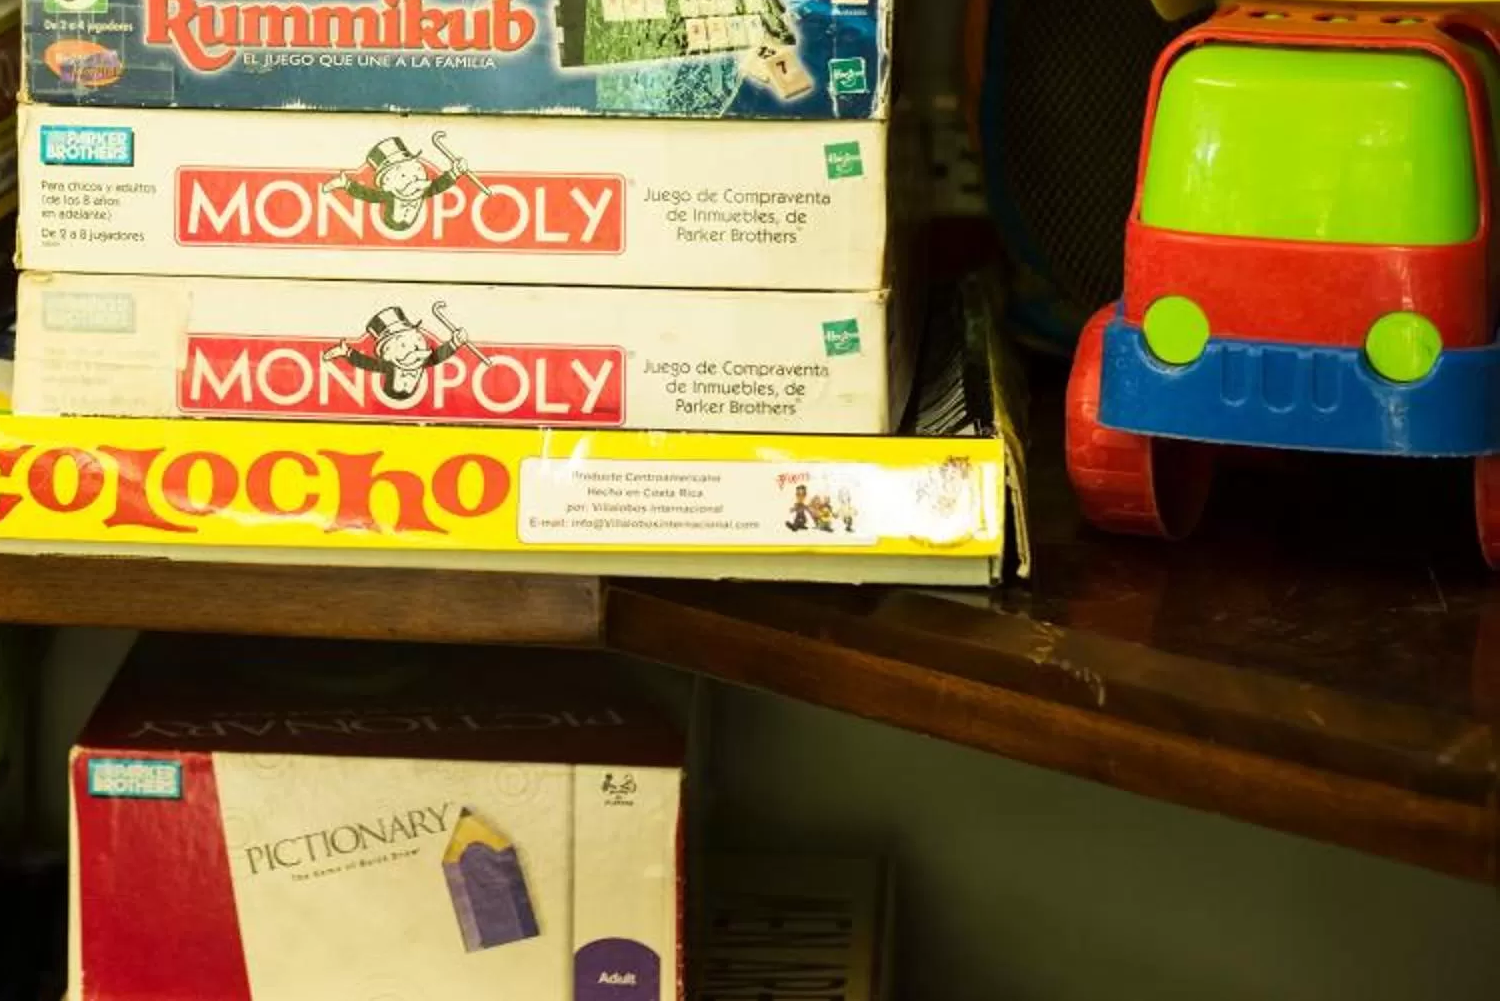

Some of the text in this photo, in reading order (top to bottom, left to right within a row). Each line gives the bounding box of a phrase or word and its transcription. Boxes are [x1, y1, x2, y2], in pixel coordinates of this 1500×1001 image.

[243, 53, 496, 69] EL JUEGO QUE UNE A LA FAMILIA
[41, 180, 65, 192] Para
[68, 181, 103, 193] chicos
[643, 188, 831, 206] Juego de Compraventa
[188, 178, 612, 243] MONOPOLY
[666, 208, 807, 225] de Inmuebles, de
[41, 228, 56, 239] De
[88, 229, 145, 243] jugadores
[677, 227, 797, 244] Parker Brothers
[643, 359, 829, 377] Juego de Compraventa
[191, 346, 613, 413] MONOPOLY
[666, 379, 805, 398] de Inmuebles, de
[676, 399, 796, 416] Parker Brothers
[587, 487, 623, 497] Hecho
[643, 488, 675, 498] Costa
[679, 489, 703, 498] Rica
[244, 803, 449, 875] PICTIONARY
[598, 972, 637, 985] Adult
